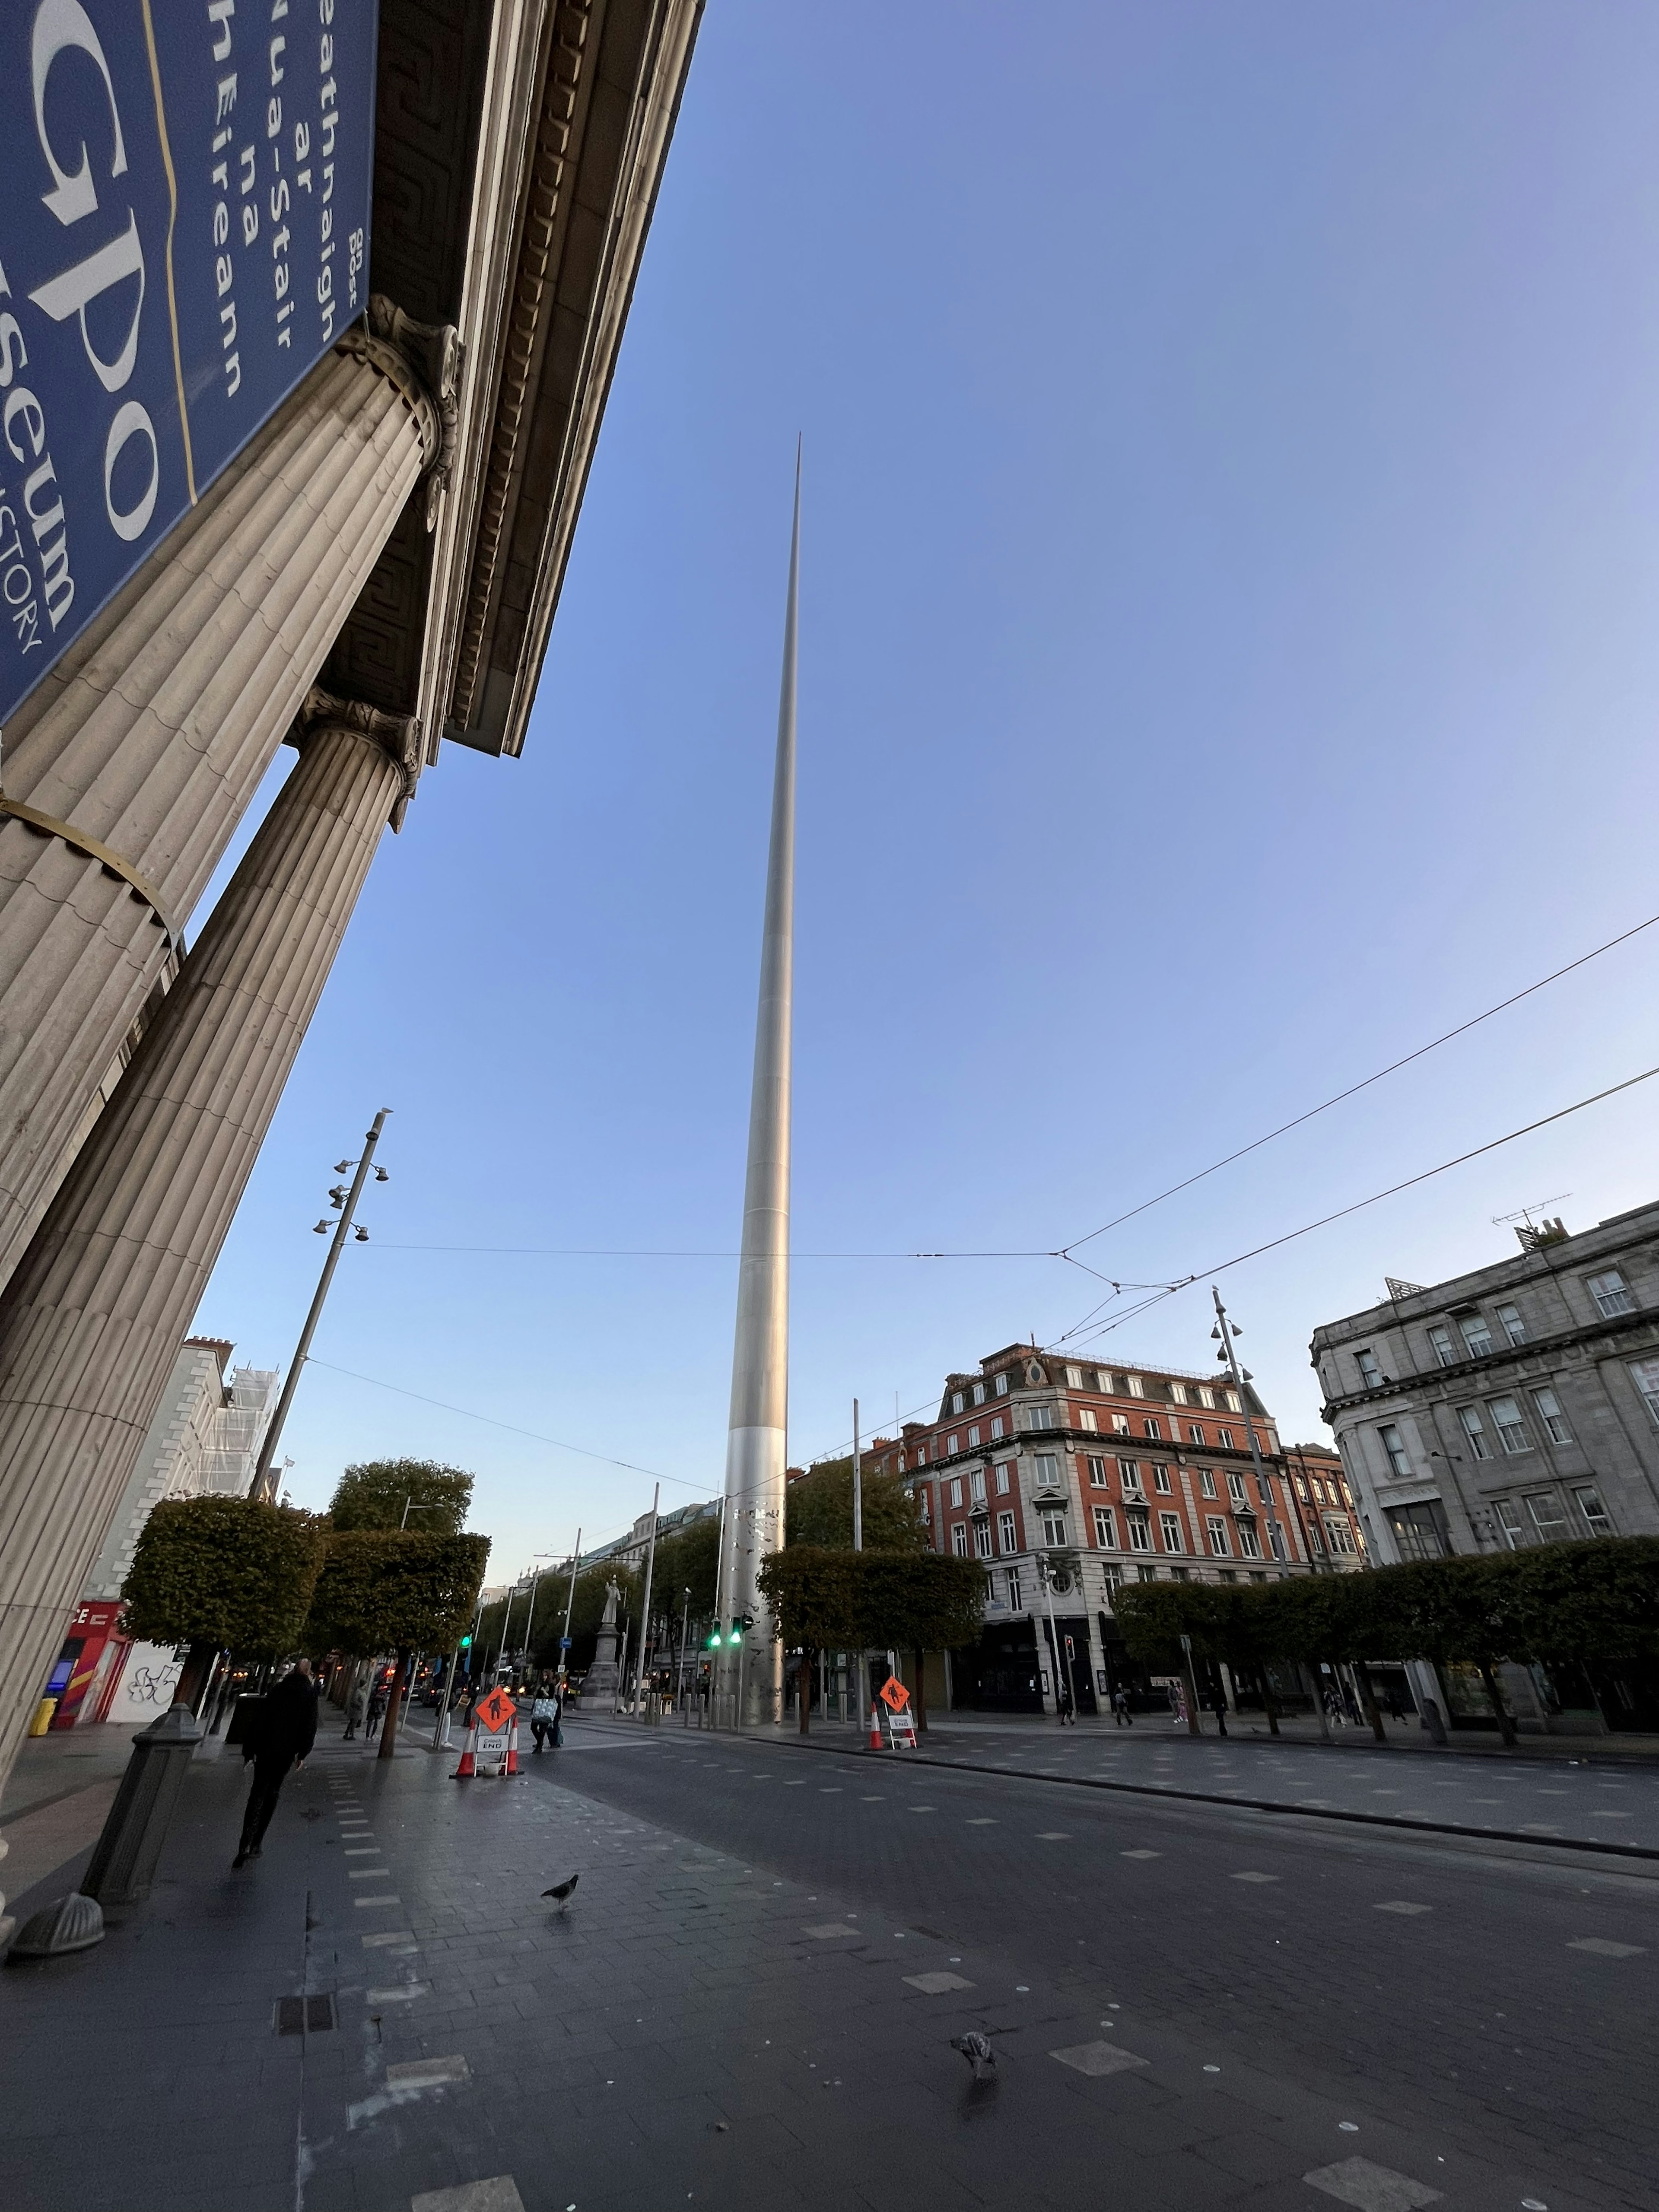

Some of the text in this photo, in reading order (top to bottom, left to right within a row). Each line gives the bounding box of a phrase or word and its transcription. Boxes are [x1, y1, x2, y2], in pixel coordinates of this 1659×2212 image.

[241, 144, 258, 247] na
[295, 121, 312, 194] ar
[27, 0, 159, 541] GPO
[349, 232, 357, 308] post
[356, 228, 363, 271] an
[0, 259, 75, 633] seum
